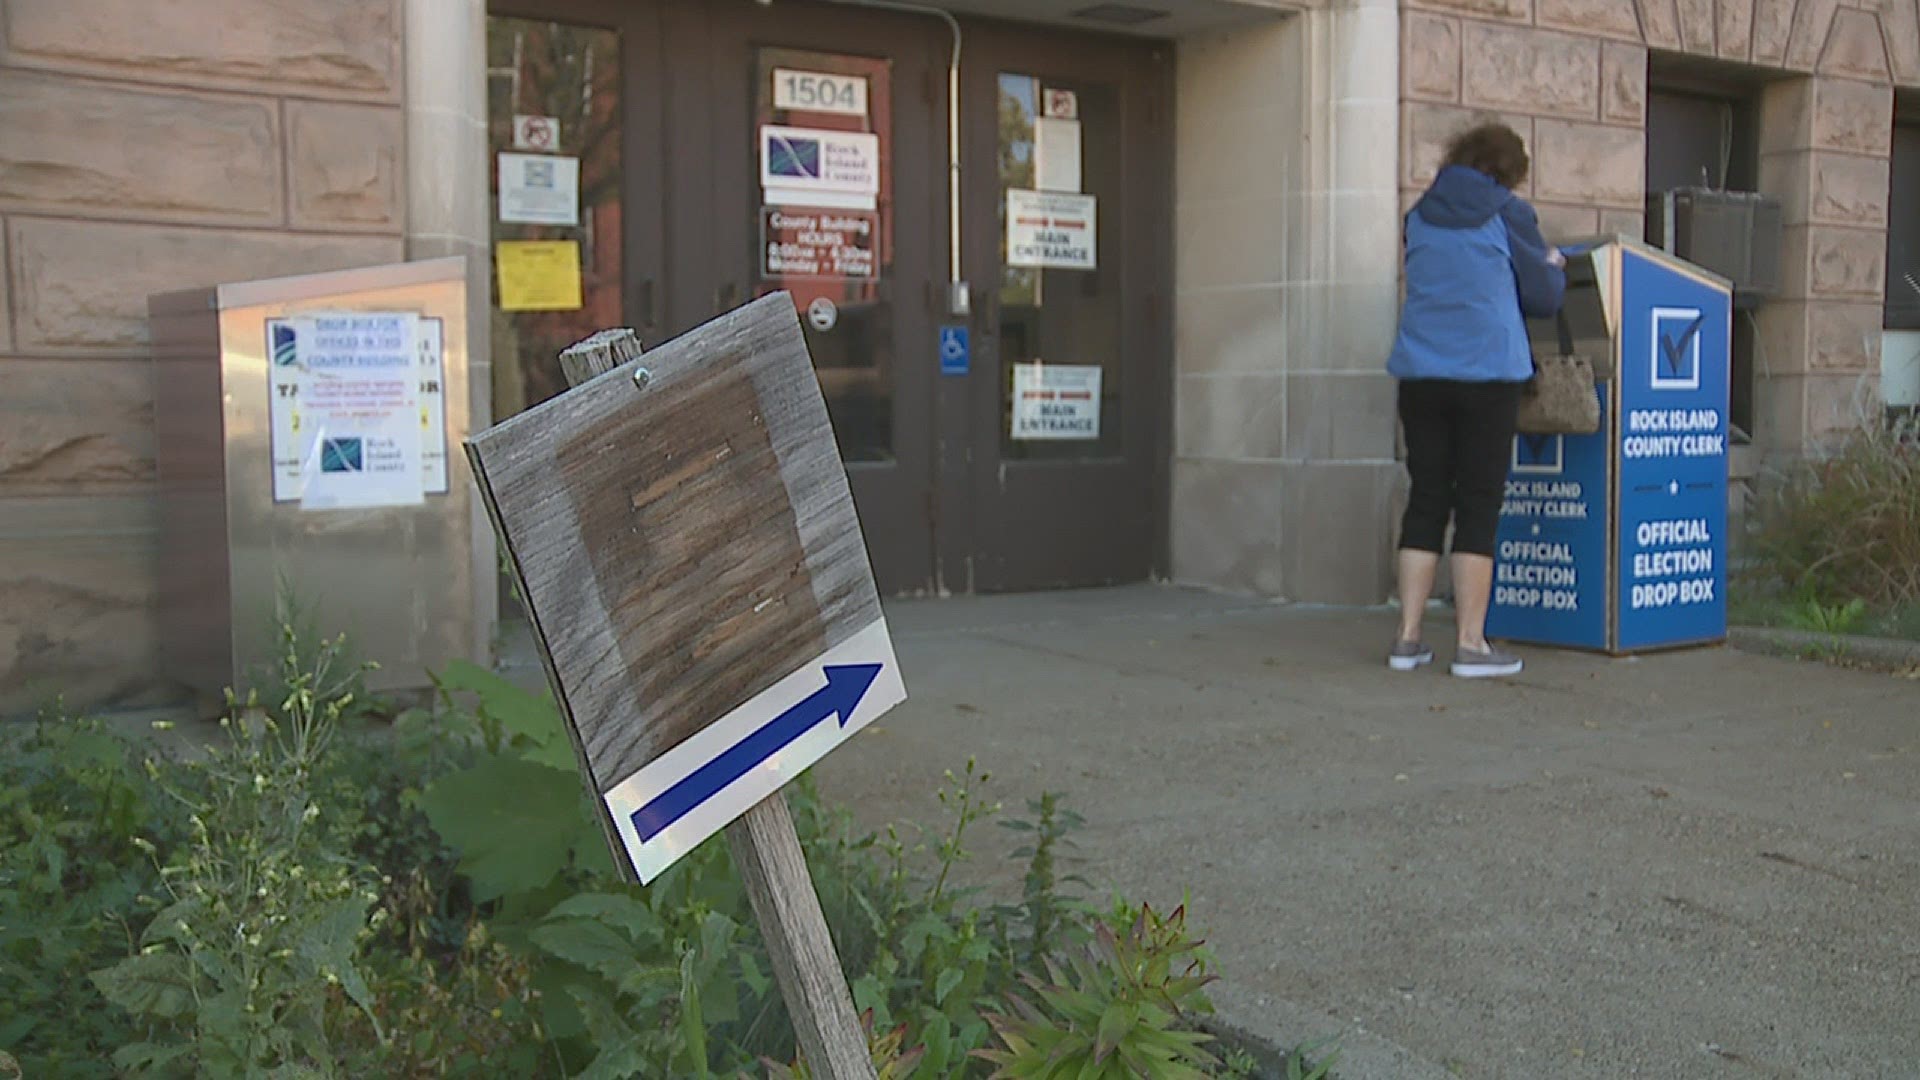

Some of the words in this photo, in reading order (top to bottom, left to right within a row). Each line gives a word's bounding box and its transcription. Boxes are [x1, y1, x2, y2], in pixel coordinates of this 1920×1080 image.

[785, 76, 855, 108] 1504
[770, 211, 817, 231] County
[821, 215, 869, 235] Building
[1034, 231, 1070, 245] MAIN
[1016, 245, 1088, 260] ENTRANCE
[768, 257, 818, 274] Monday
[834, 259, 872, 276] Friday
[1041, 404, 1076, 416] MAIN
[1630, 410, 1668, 431] ROCK
[1669, 409, 1718, 430] ISLAND
[1020, 418, 1092, 431] ENTRANCE
[1624, 435, 1681, 458] COUNTY
[1682, 434, 1723, 456] CLERK
[1503, 480, 1531, 497] OCK
[1532, 481, 1581, 499] ISLAND
[1544, 501, 1587, 518] CLERK
[1637, 518, 1710, 546] OFFICIAL
[1500, 540, 1574, 562] OFFICIAL
[1498, 562, 1576, 586] ELECTION
[1634, 548, 1712, 578] ELECTION
[1495, 586, 1540, 608] DROP
[1542, 589, 1578, 610] BOX
[1632, 581, 1678, 609] DROP
[1680, 577, 1714, 603] BOX
